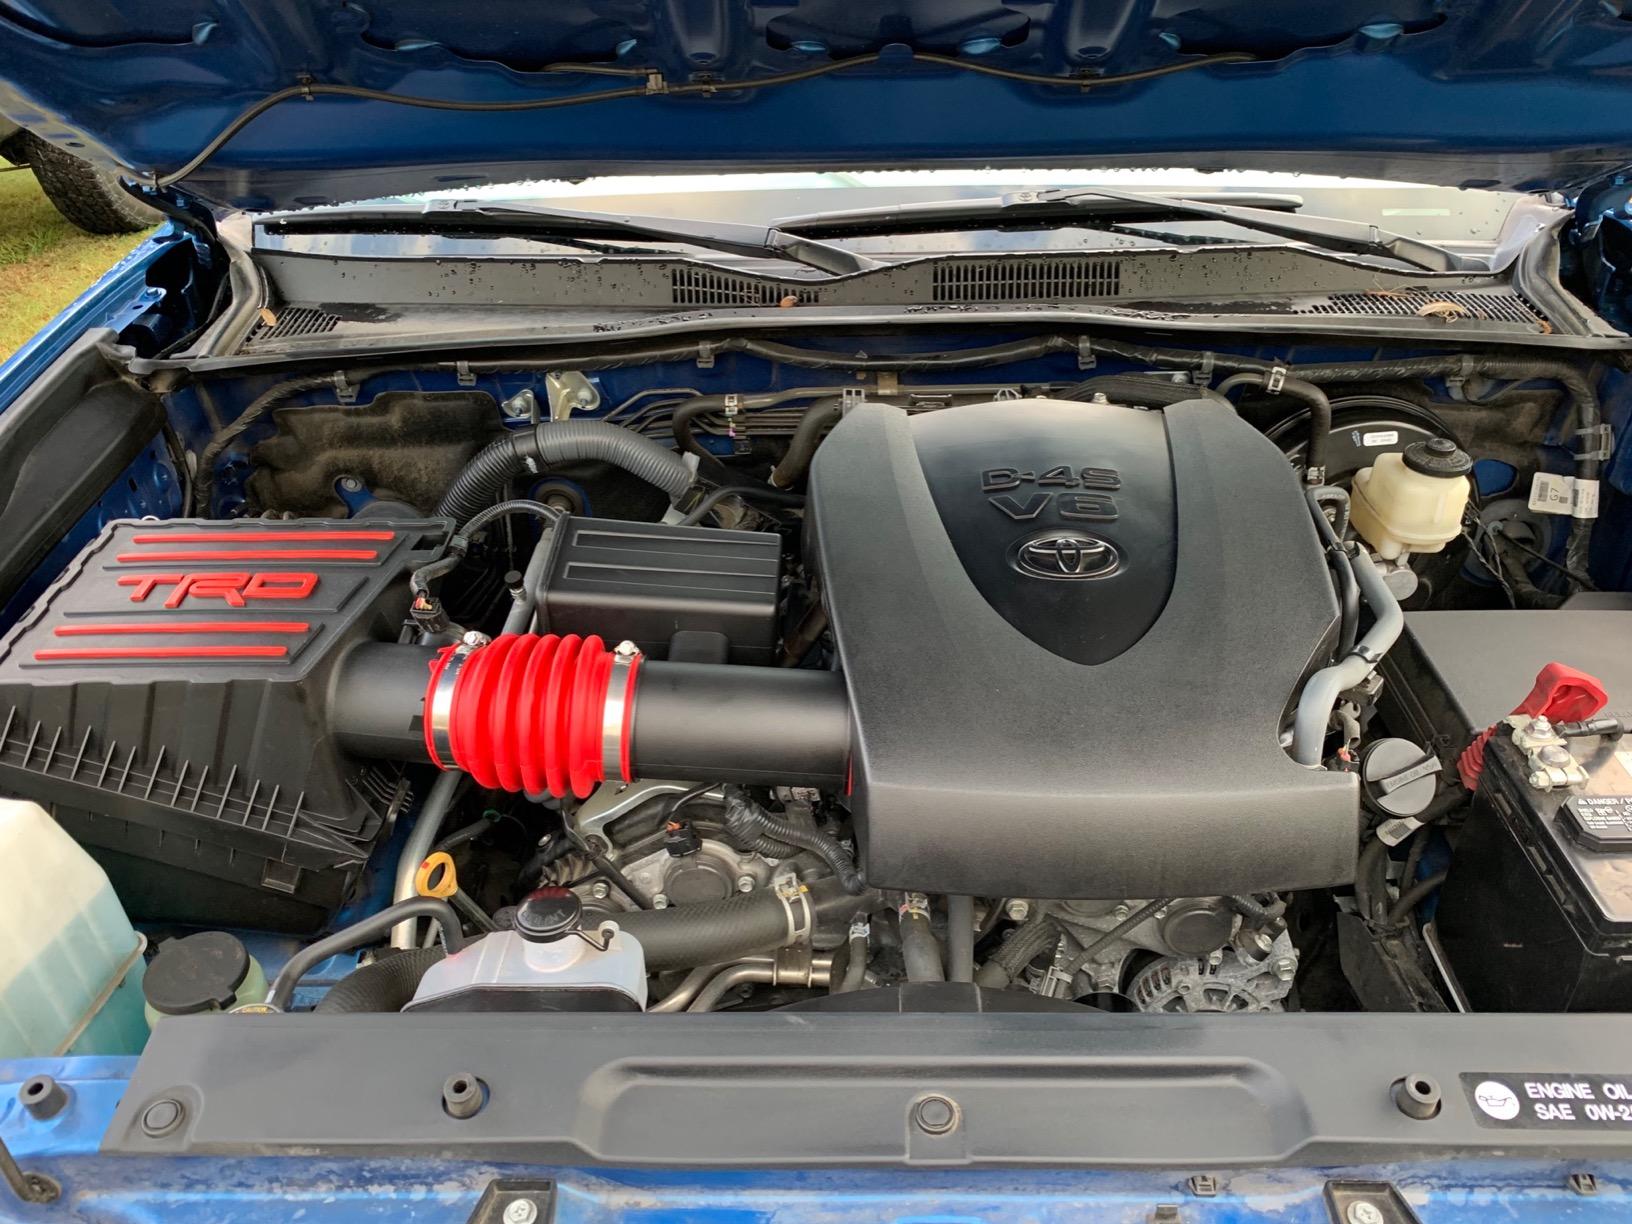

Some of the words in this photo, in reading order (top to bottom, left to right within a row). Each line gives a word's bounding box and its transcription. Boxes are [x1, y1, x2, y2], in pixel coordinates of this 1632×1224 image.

[981, 465, 1121, 491] D-4S
[988, 491, 1120, 519] V6
[1549, 487, 1560, 501] G7
[117, 572, 319, 608] TRD
[1524, 1082, 1595, 1099] ENGINE
[1602, 1083, 1632, 1100] OIL
[1534, 1103, 1576, 1120] SAE
[1584, 1104, 1632, 1121] 0W-2
